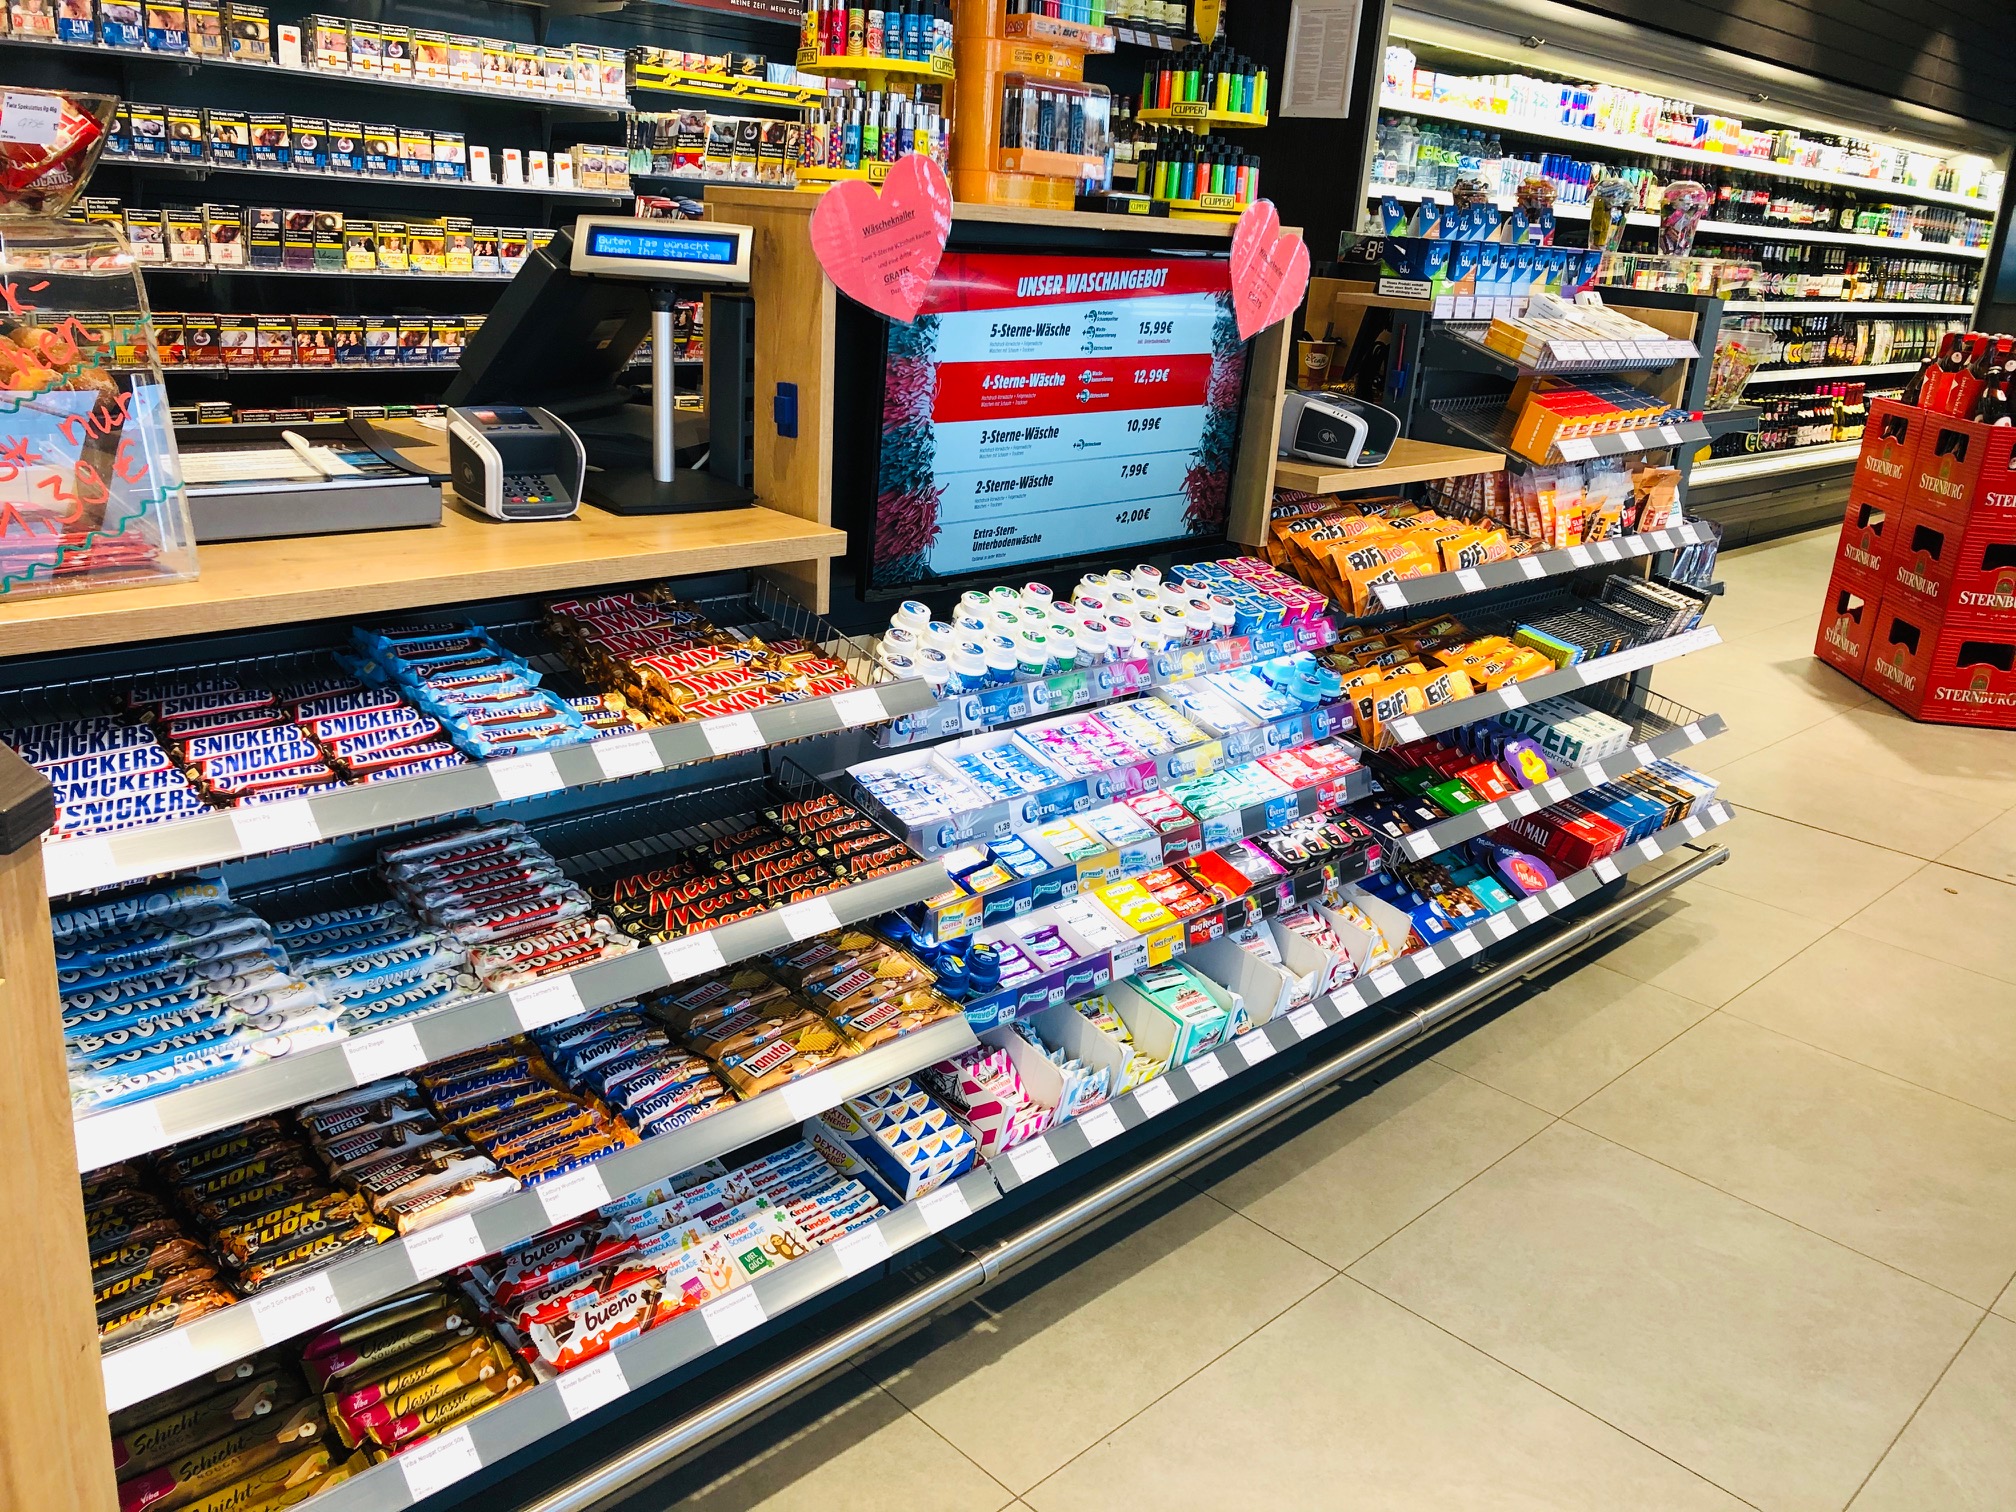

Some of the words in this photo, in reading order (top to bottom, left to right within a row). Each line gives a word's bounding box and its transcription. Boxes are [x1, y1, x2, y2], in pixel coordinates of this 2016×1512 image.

[753, 1, 768, 10] ZEIT.
[770, 5, 786, 13] MEIN
[1062, 28, 1079, 38] BIC
[18, 104, 42, 112] Spekulatius
[1173, 104, 1206, 115] CLIPPER
[1130, 202, 1149, 212] CLIPPER
[1203, 195, 1234, 207] CLIPPER
[862, 209, 916, 236] Wäscheknaller
[598, 244, 631, 255] Ihnen
[638, 248, 656, 257] Ihr
[663, 249, 722, 261] Star-Team
[599, 235, 632, 246] Guten
[638, 238, 658, 247] Tag
[663, 240, 710, 251] wünscht
[1400, 264, 1410, 274] blu
[1431, 254, 1441, 265] blu
[1461, 256, 1470, 267] blu
[1482, 254, 1491, 267] blu
[884, 266, 910, 284] GRATIS
[1017, 275, 1064, 297] UNSER
[1065, 268, 1169, 293] WASCHANGEBOT
[990, 322, 1071, 338] 5-Sterne-Wäsche
[1138, 321, 1174, 335] 15,99€
[982, 372, 1066, 390] 4-Sterne-Wäsche
[1133, 368, 1170, 385] 12,99€
[1127, 417, 1161, 432] 10,99€
[980, 426, 1059, 445] 3-Sterne-Wäsche
[1121, 462, 1149, 478] 7,99€
[1865, 455, 1904, 480] STERNBURG
[975, 474, 1053, 494] 2-Sterne-Wäsche
[1919, 472, 1965, 501] STERNBURG
[1115, 508, 1151, 524] +2,00€
[973, 525, 1018, 540] Extra-Stern-
[1345, 519, 1366, 535] Roll
[972, 533, 1042, 551] Unterbodenwäsche
[1346, 546, 1387, 571] BiFi
[1388, 544, 1407, 562] Roll
[1458, 542, 1488, 569] BiFi
[1489, 539, 1507, 558] Roll
[1844, 543, 1882, 571] STERNBURG
[1896, 565, 1940, 598] STERNBURG
[587, 627, 680, 652] TWIX
[1824, 627, 1860, 659] STERNBURG
[633, 645, 727, 679] TWIX
[1036, 688, 1062, 699] Extra
[1425, 675, 1453, 705] BiFi
[163, 689, 272, 716] SNICKERS
[968, 704, 996, 716] Extra
[1377, 689, 1409, 721] BiFi
[900, 718, 927, 729] Extra
[22, 723, 156, 764] SNICKERS
[193, 724, 299, 758] SNICKERS
[1499, 710, 1583, 763] GIZEH
[211, 740, 316, 777] SNICKERS
[1542, 749, 1574, 770] MENTHOL
[64, 788, 201, 830] SNICKERS
[1026, 804, 1055, 820] Extra
[942, 830, 973, 844] Extra
[1526, 823, 1549, 847] MALL
[614, 860, 696, 902] Mars
[650, 873, 733, 916] Mars
[472, 895, 563, 928] BOUNTY
[666, 887, 751, 931] Mars
[941, 920, 962, 930] KOFFEIN
[497, 921, 592, 960] BOUNTY
[829, 972, 871, 999] hanuta
[860, 1005, 895, 1030] hanuta
[579, 1031, 637, 1064] Knoppers
[751, 1043, 791, 1074] hanuta
[330, 1117, 365, 1136] RIEGEL
[652, 1100, 711, 1134] Knoppers
[822, 1113, 849, 1130] ENERGY
[194, 1139, 248, 1167] LION
[344, 1141, 379, 1161] RIEGEL
[813, 1133, 847, 1161] DEXTRO
[207, 1160, 266, 1193] LION
[823, 1184, 859, 1208] Riegel
[706, 1213, 732, 1228] kinder
[832, 1200, 870, 1221] Riegel
[723, 1227, 750, 1241] kinder
[729, 1227, 766, 1246] SCHOKOLADE
[521, 1231, 577, 1268] bueno
[745, 1251, 759, 1263] VIEL
[748, 1257, 766, 1271] GLÜCK
[258, 1303, 271, 1314] Lion
[285, 1289, 304, 1302] Peanut
[585, 1293, 638, 1331] bueno
[589, 1294, 619, 1310] kinder
[372, 1343, 406, 1361] NOUGAT
[384, 1364, 432, 1396] Classic
[393, 1382, 441, 1418] Classic
[423, 1392, 470, 1424] Classic
